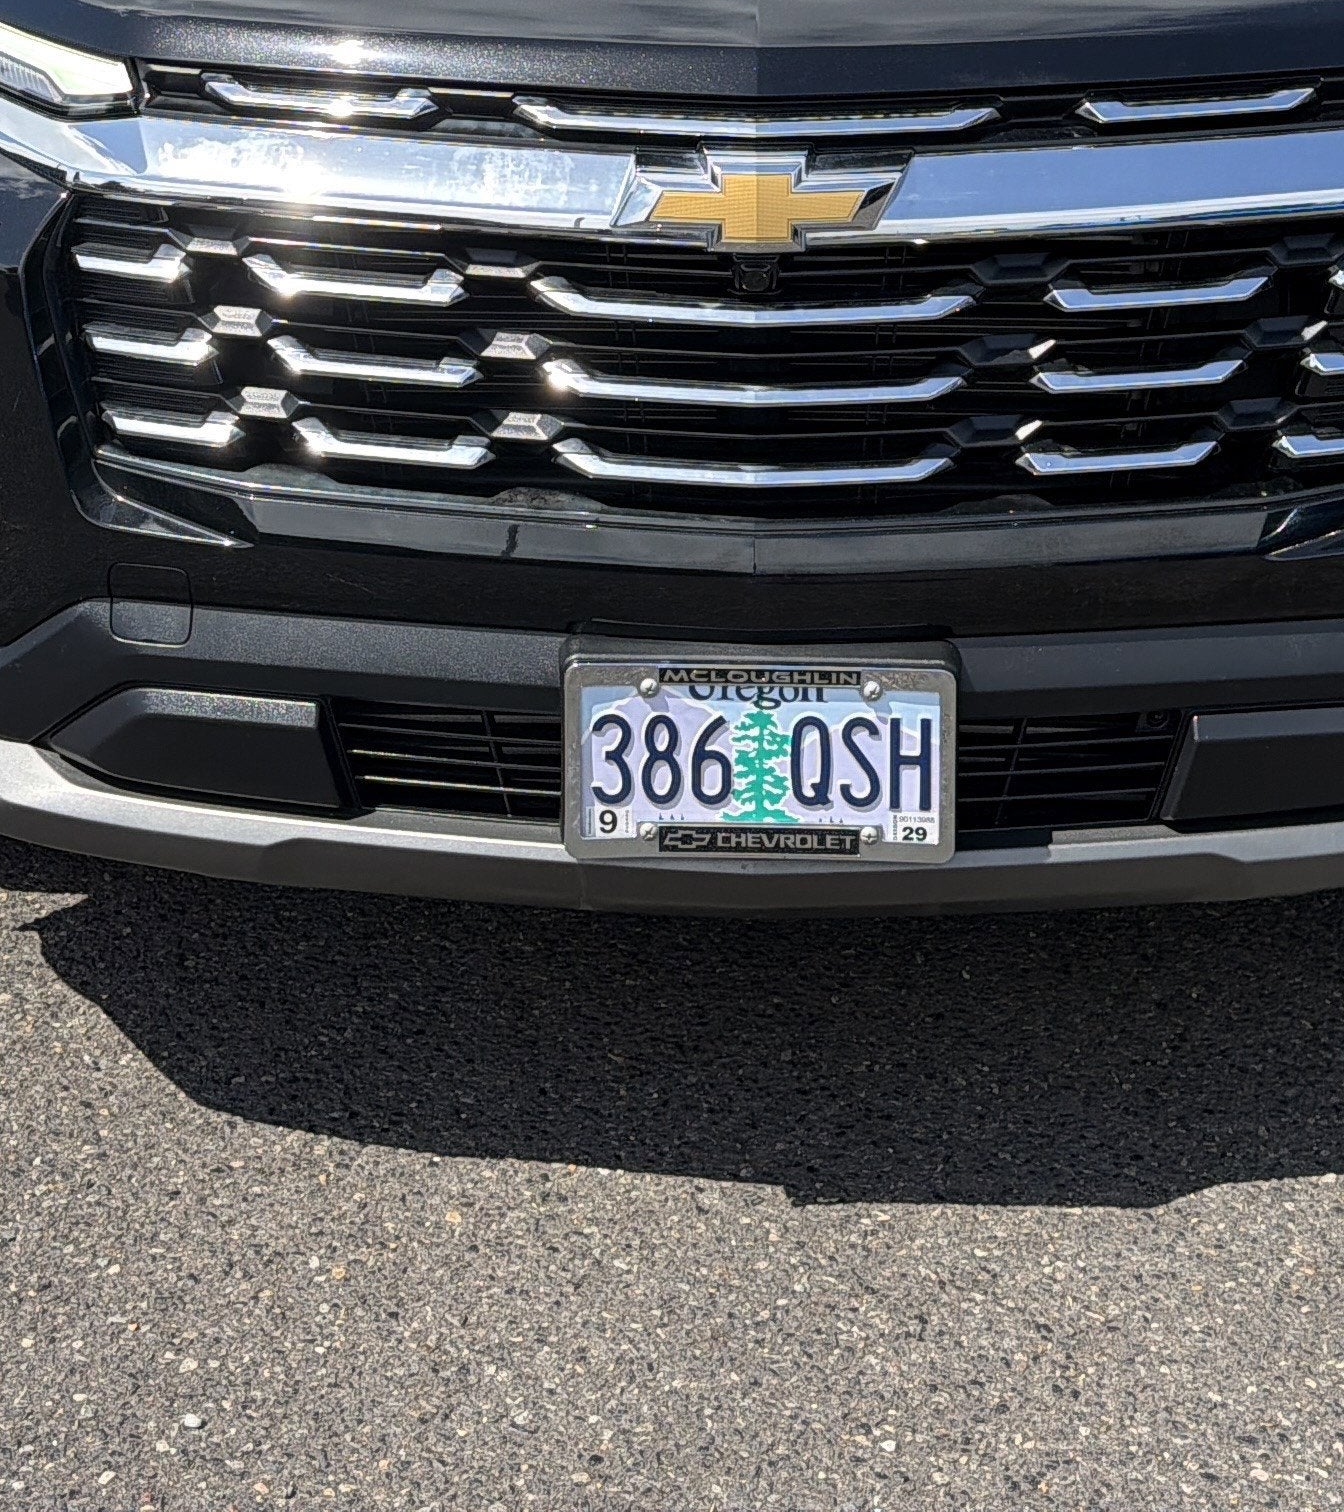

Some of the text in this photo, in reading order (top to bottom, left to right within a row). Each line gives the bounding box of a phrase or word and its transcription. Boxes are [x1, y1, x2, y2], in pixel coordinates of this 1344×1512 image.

[662, 669, 856, 685] MCLOUGHLIN
[688, 684, 829, 711] Oregon
[592, 713, 932, 811] 386 QSH
[598, 809, 618, 834] 9
[717, 832, 856, 850] CHEVROLET
[901, 826, 928, 841] 29
